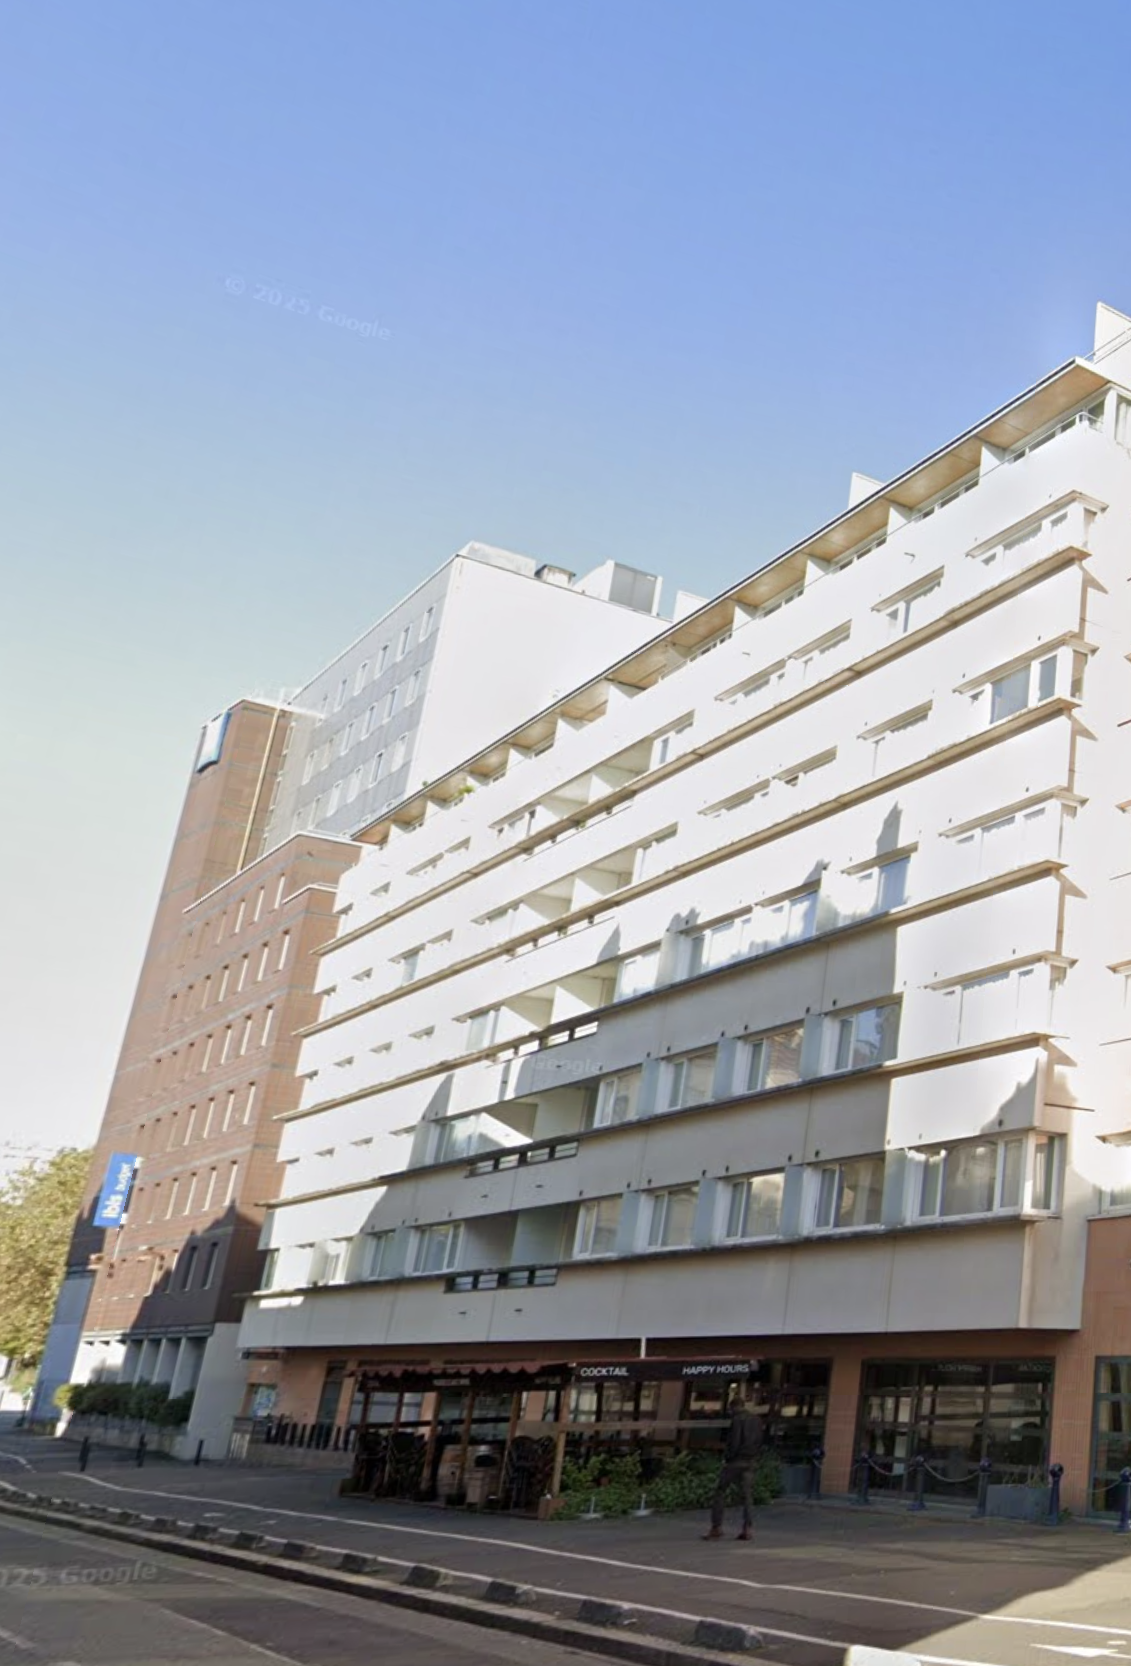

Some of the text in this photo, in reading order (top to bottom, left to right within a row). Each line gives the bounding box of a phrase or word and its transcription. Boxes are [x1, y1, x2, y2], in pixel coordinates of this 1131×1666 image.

[102, 1195, 123, 1218] ibis
[580, 1363, 750, 1377] COCKTAIL HAPPY HOURS
